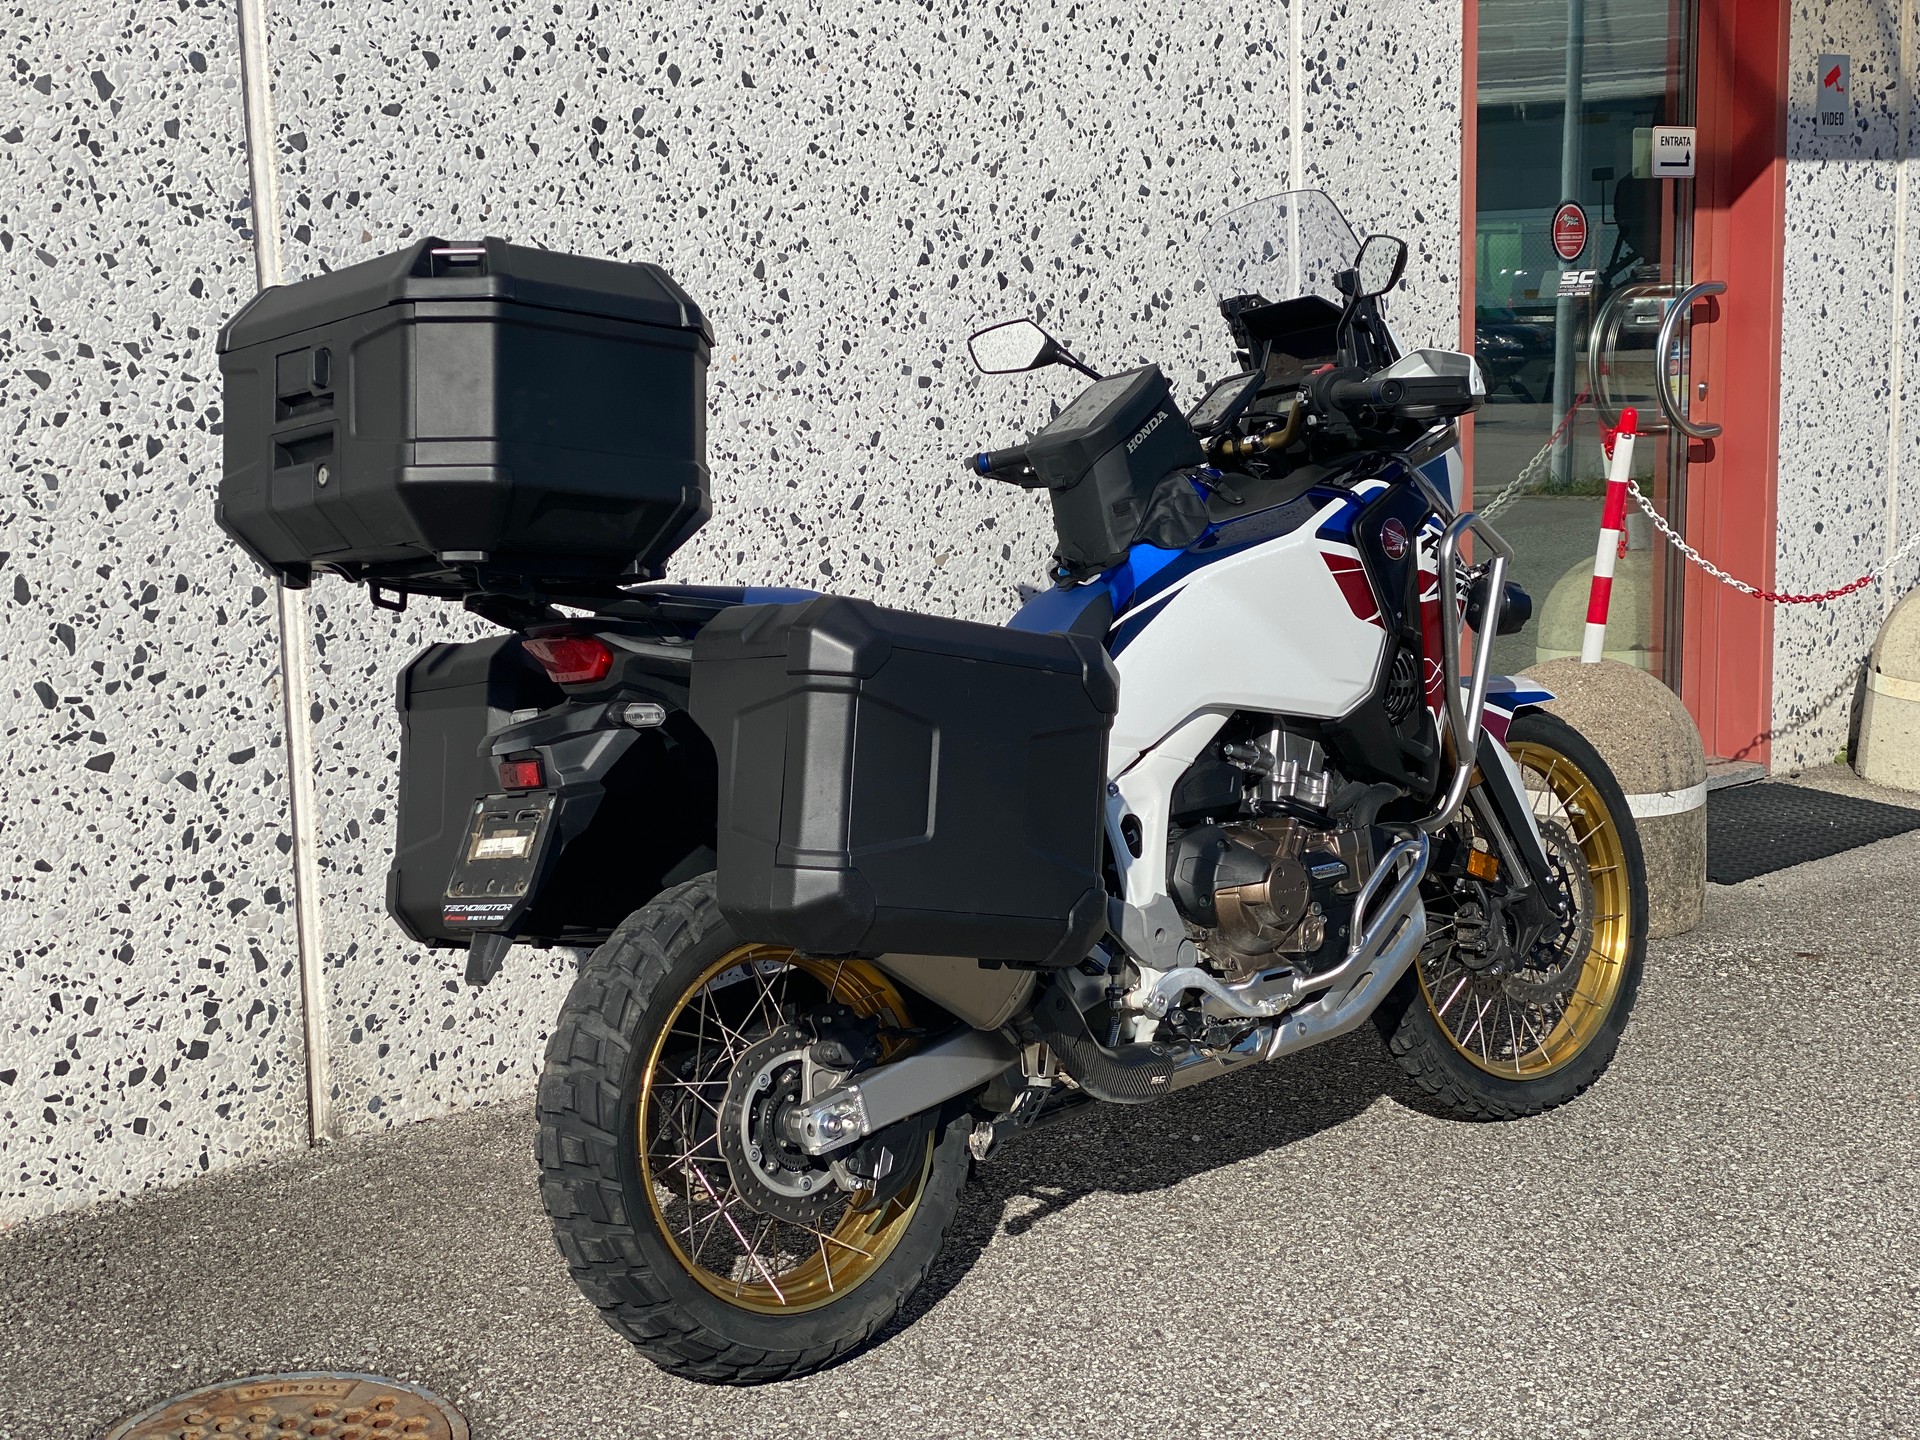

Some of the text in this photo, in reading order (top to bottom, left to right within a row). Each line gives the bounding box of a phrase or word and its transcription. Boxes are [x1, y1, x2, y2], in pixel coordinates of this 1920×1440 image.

[1821, 111, 1845, 126] VIDEO
[1660, 135, 1691, 147] ENTRATA
[1560, 270, 1596, 285] SC
[1126, 410, 1169, 454] HONDA
[443, 904, 513, 912] TECNOMOTOR
